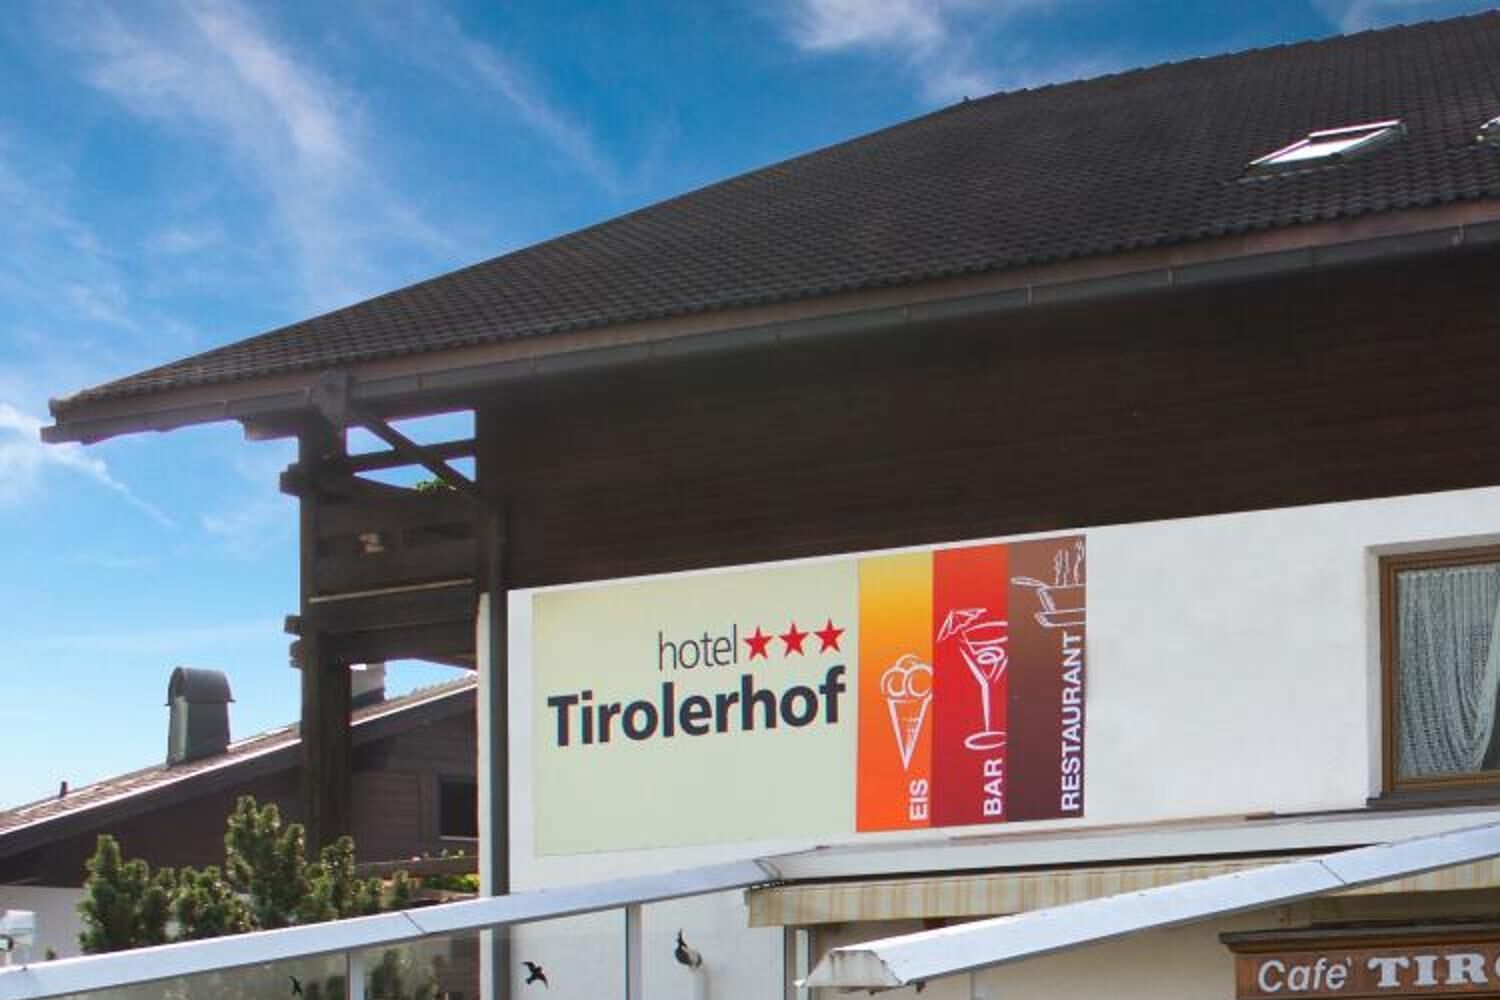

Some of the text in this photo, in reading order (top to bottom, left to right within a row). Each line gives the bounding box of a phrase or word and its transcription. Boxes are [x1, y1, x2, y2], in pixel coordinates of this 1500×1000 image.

[658, 623, 737, 672] hotel
[547, 665, 846, 747] Tirolerhof
[1061, 631, 1082, 811] RESTAURANT
[909, 778, 929, 821] EIS
[983, 758, 1003, 816] BAR
